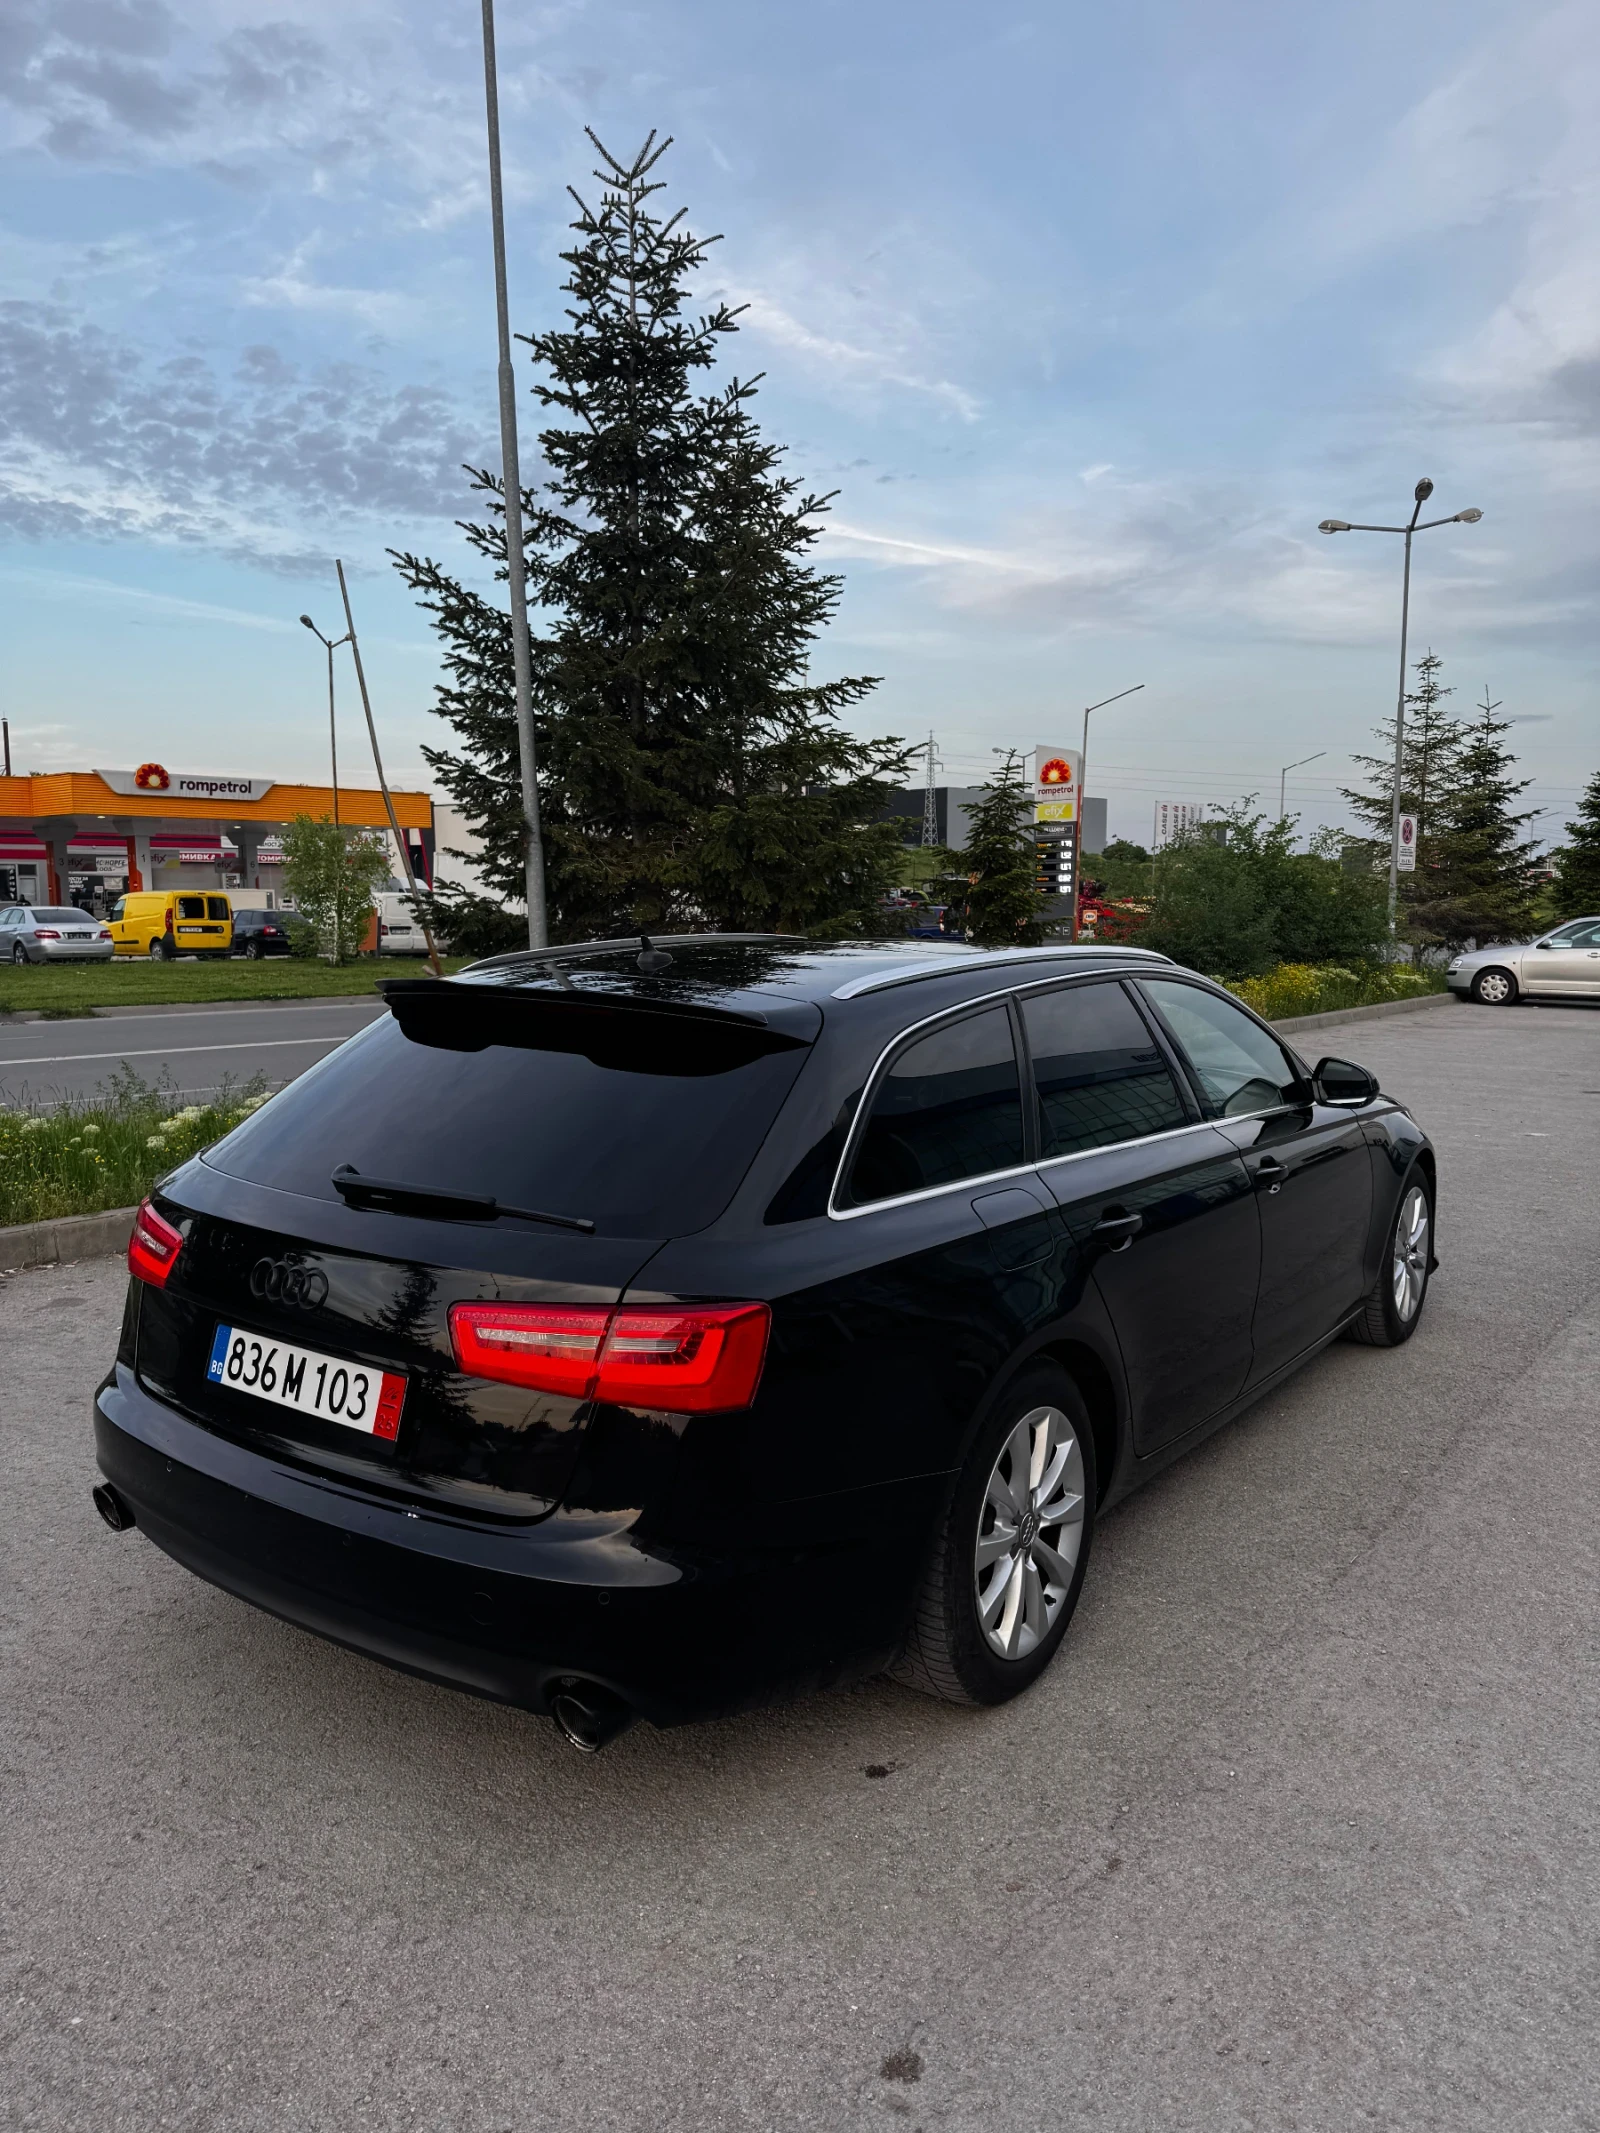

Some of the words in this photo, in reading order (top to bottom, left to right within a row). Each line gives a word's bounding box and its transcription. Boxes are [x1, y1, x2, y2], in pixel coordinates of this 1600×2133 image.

[179, 779, 252, 796] rompetrol
[1038, 785, 1074, 796] rompetrol
[1044, 804, 1067, 819] efix
[211, 1359, 223, 1375] BG
[227, 1337, 279, 1392] 836
[281, 1353, 307, 1402] M
[314, 1362, 369, 1420] 103
